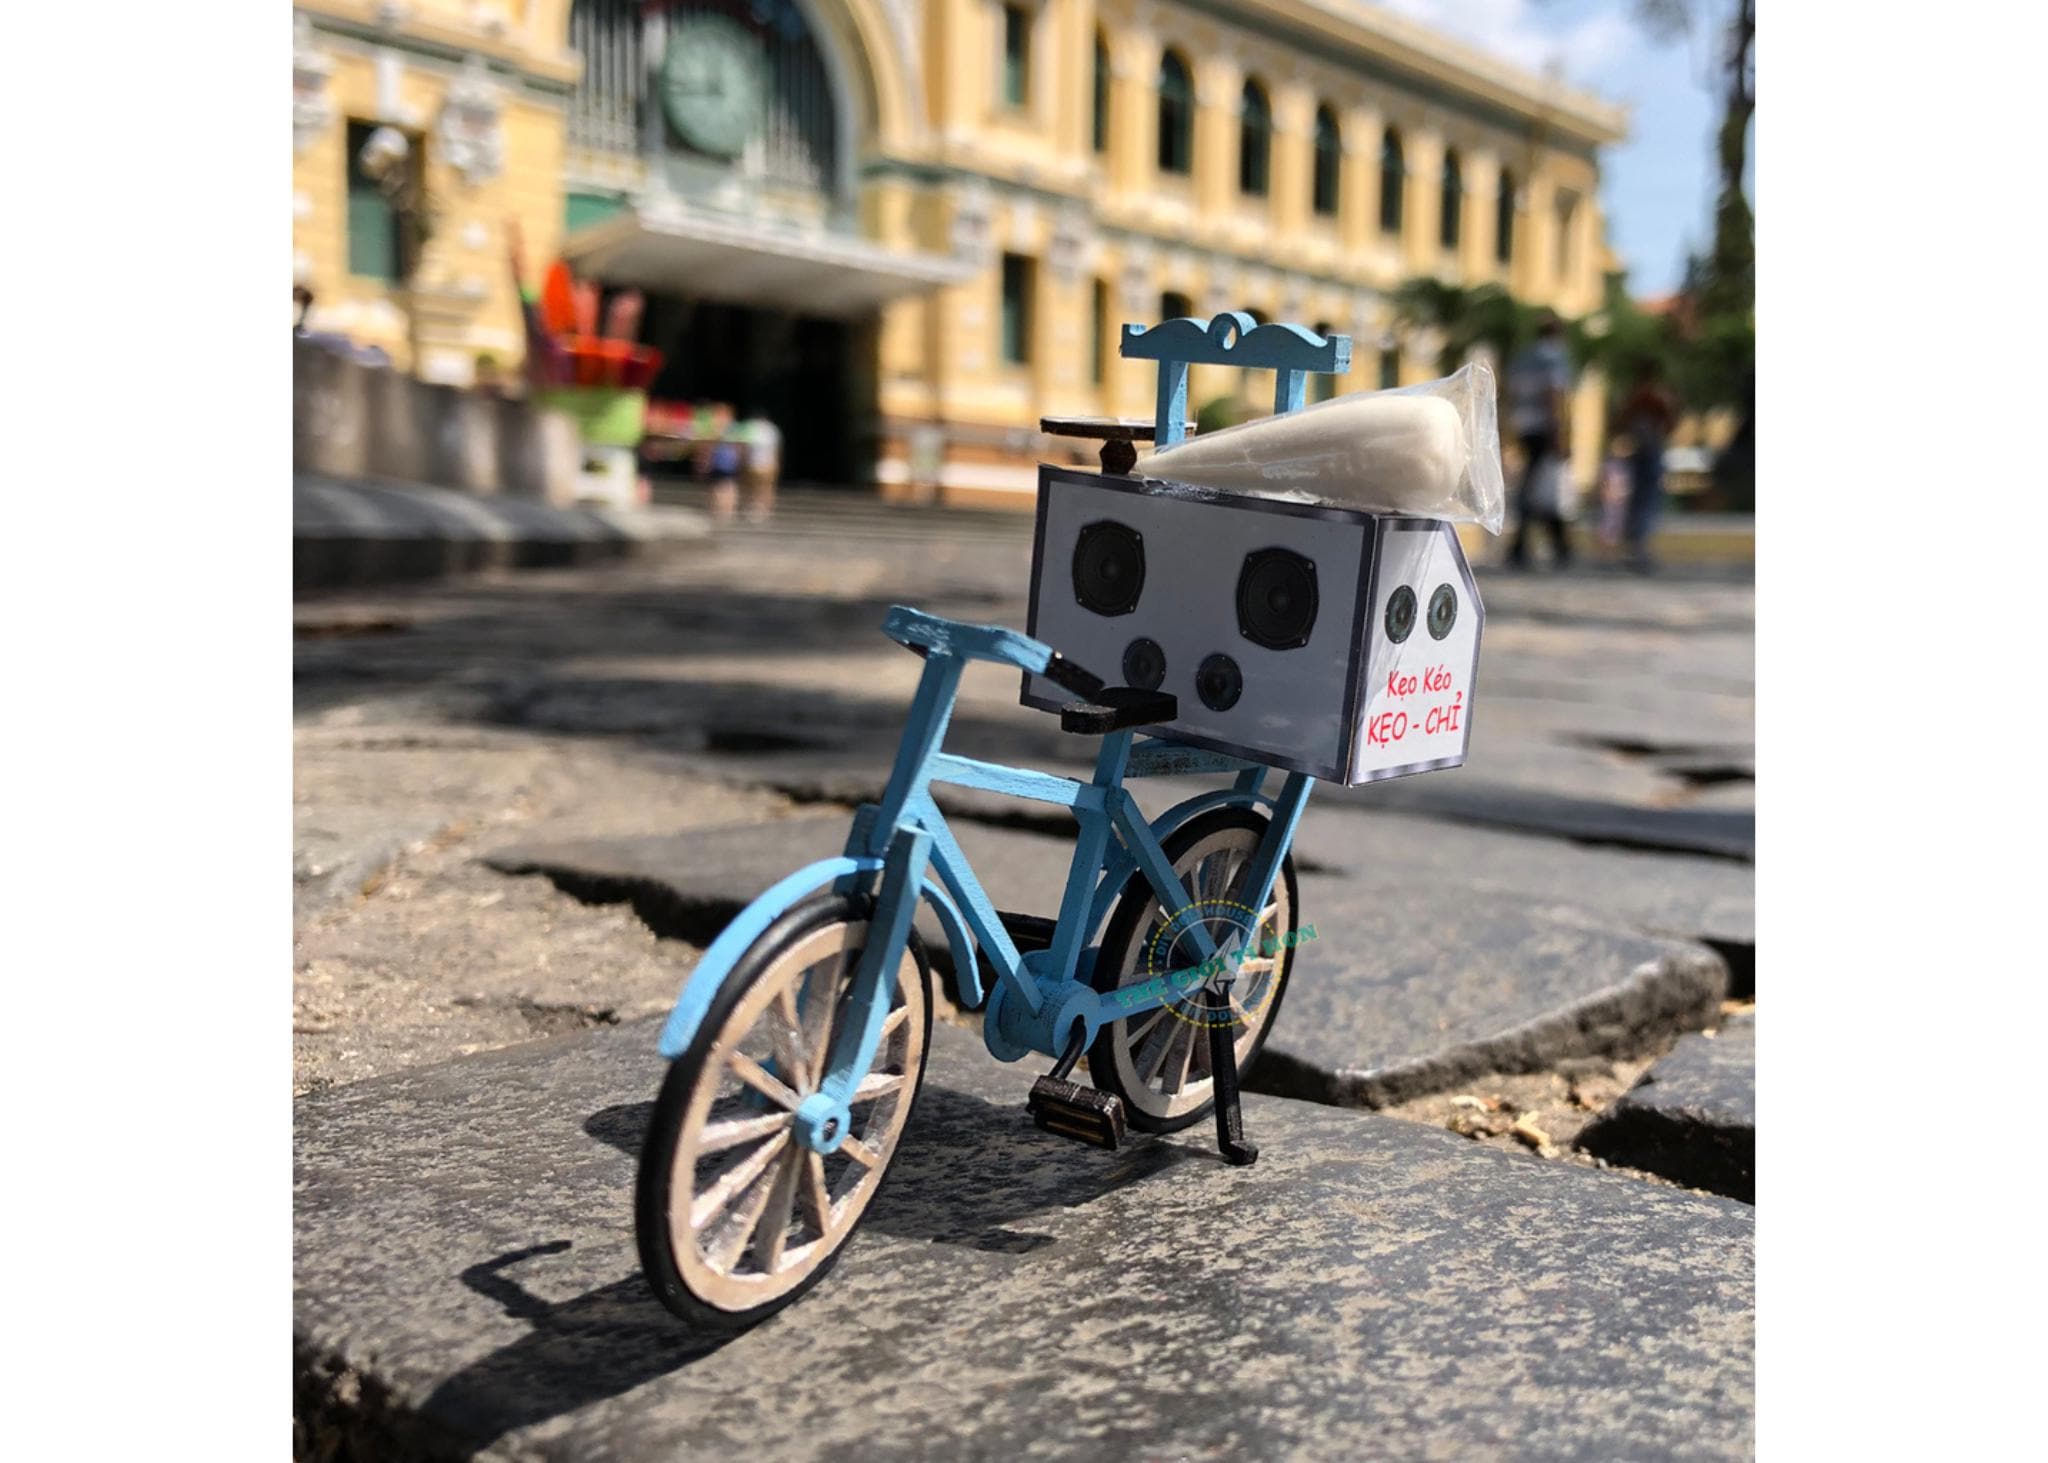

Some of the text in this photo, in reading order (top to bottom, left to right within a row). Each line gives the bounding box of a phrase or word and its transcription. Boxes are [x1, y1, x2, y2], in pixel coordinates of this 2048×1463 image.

[1387, 664, 1452, 701] Kẹo Kéo
[1367, 711, 1408, 749] KẸO
[1425, 691, 1463, 735] CHỈ
